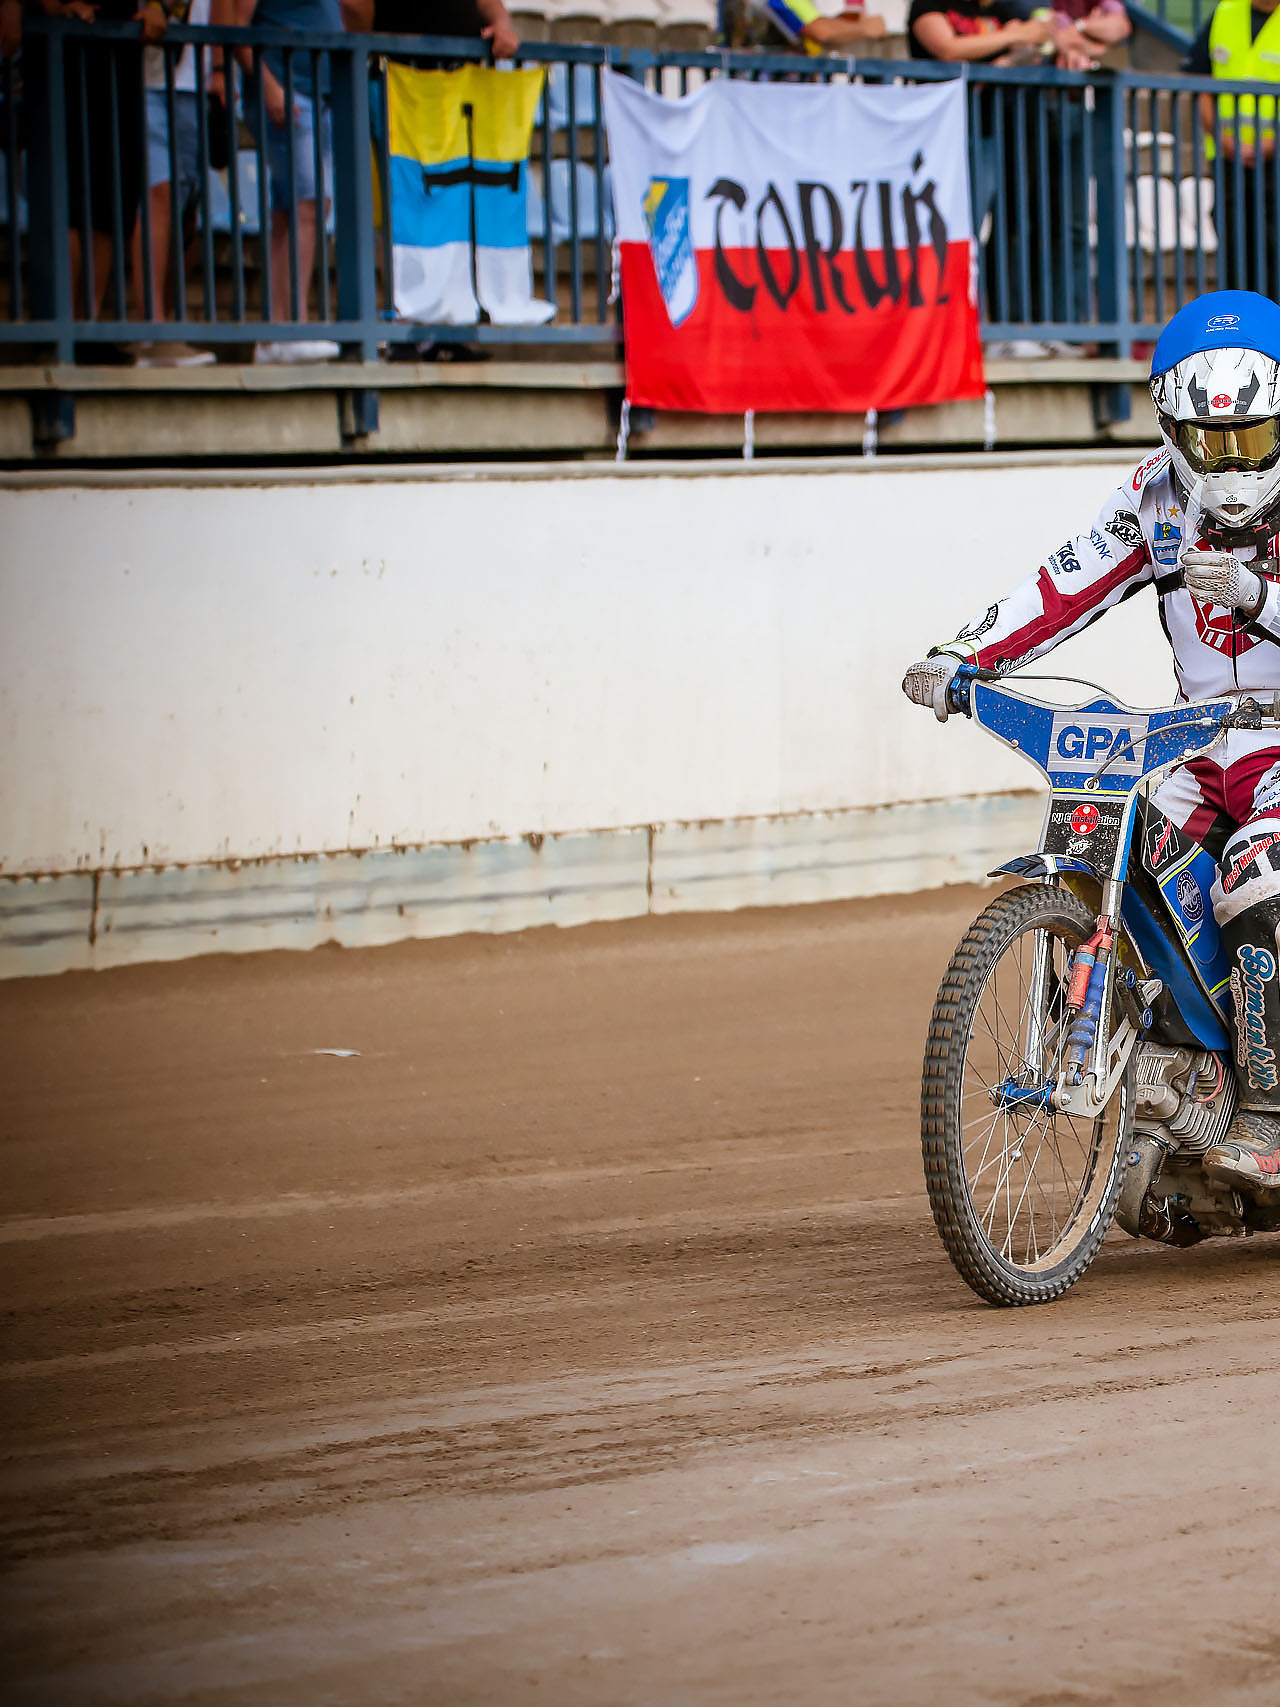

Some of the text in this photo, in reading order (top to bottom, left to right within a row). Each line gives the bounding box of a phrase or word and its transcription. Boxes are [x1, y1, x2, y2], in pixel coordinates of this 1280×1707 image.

[1056, 725, 1136, 762] GPA
[1223, 862, 1241, 894] Plast
[1239, 836, 1274, 871] Montage
